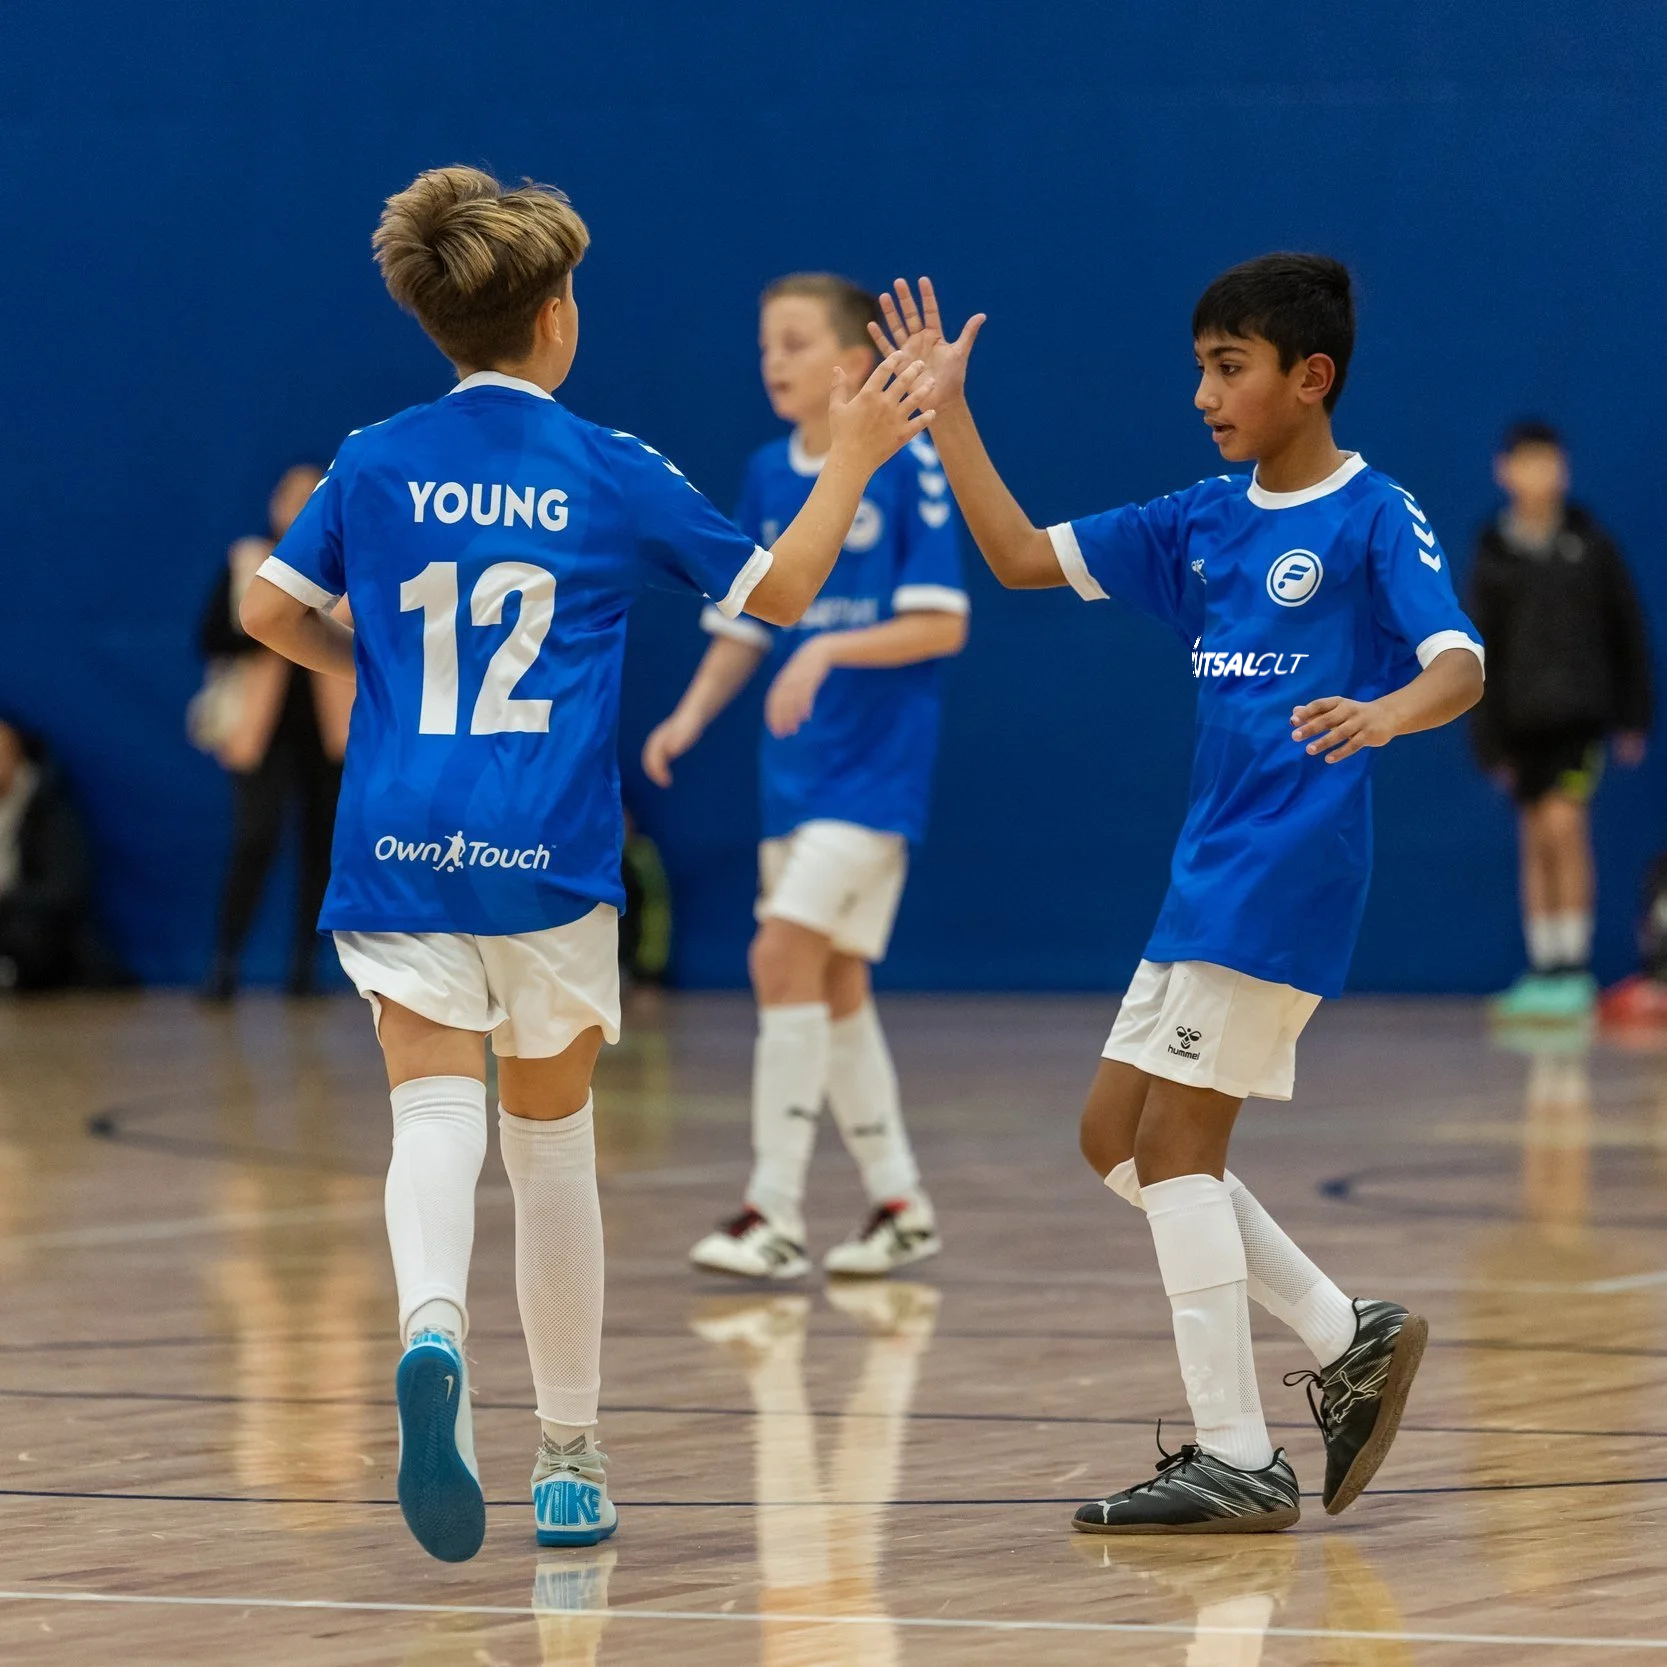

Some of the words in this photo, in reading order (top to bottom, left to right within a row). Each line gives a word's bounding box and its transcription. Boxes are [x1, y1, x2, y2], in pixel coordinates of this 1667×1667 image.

[408, 481, 568, 532] YOUNG
[400, 561, 557, 735] 12
[375, 835, 442, 862] Own
[469, 841, 550, 870] Touch
[1167, 1044, 1200, 1060] hummel
